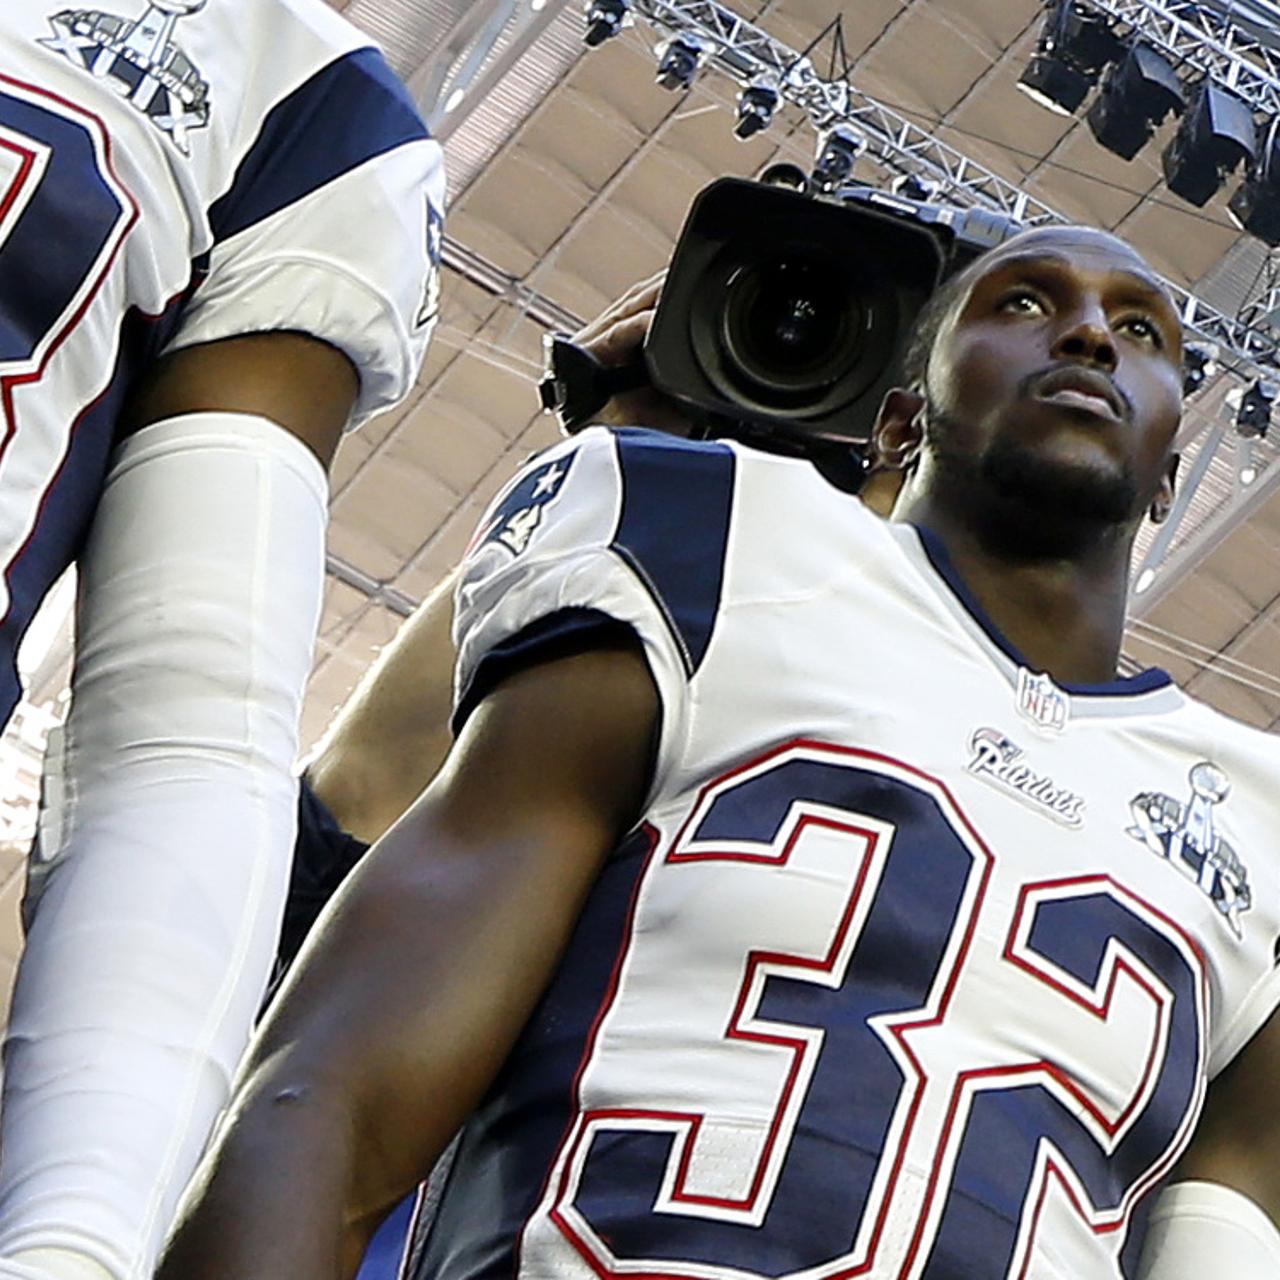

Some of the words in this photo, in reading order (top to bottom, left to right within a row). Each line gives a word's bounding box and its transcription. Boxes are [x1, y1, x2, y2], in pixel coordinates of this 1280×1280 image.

[1025, 692, 1064, 724] NFL
[968, 737, 1084, 825] Patriots
[548, 737, 1208, 1280] 32
